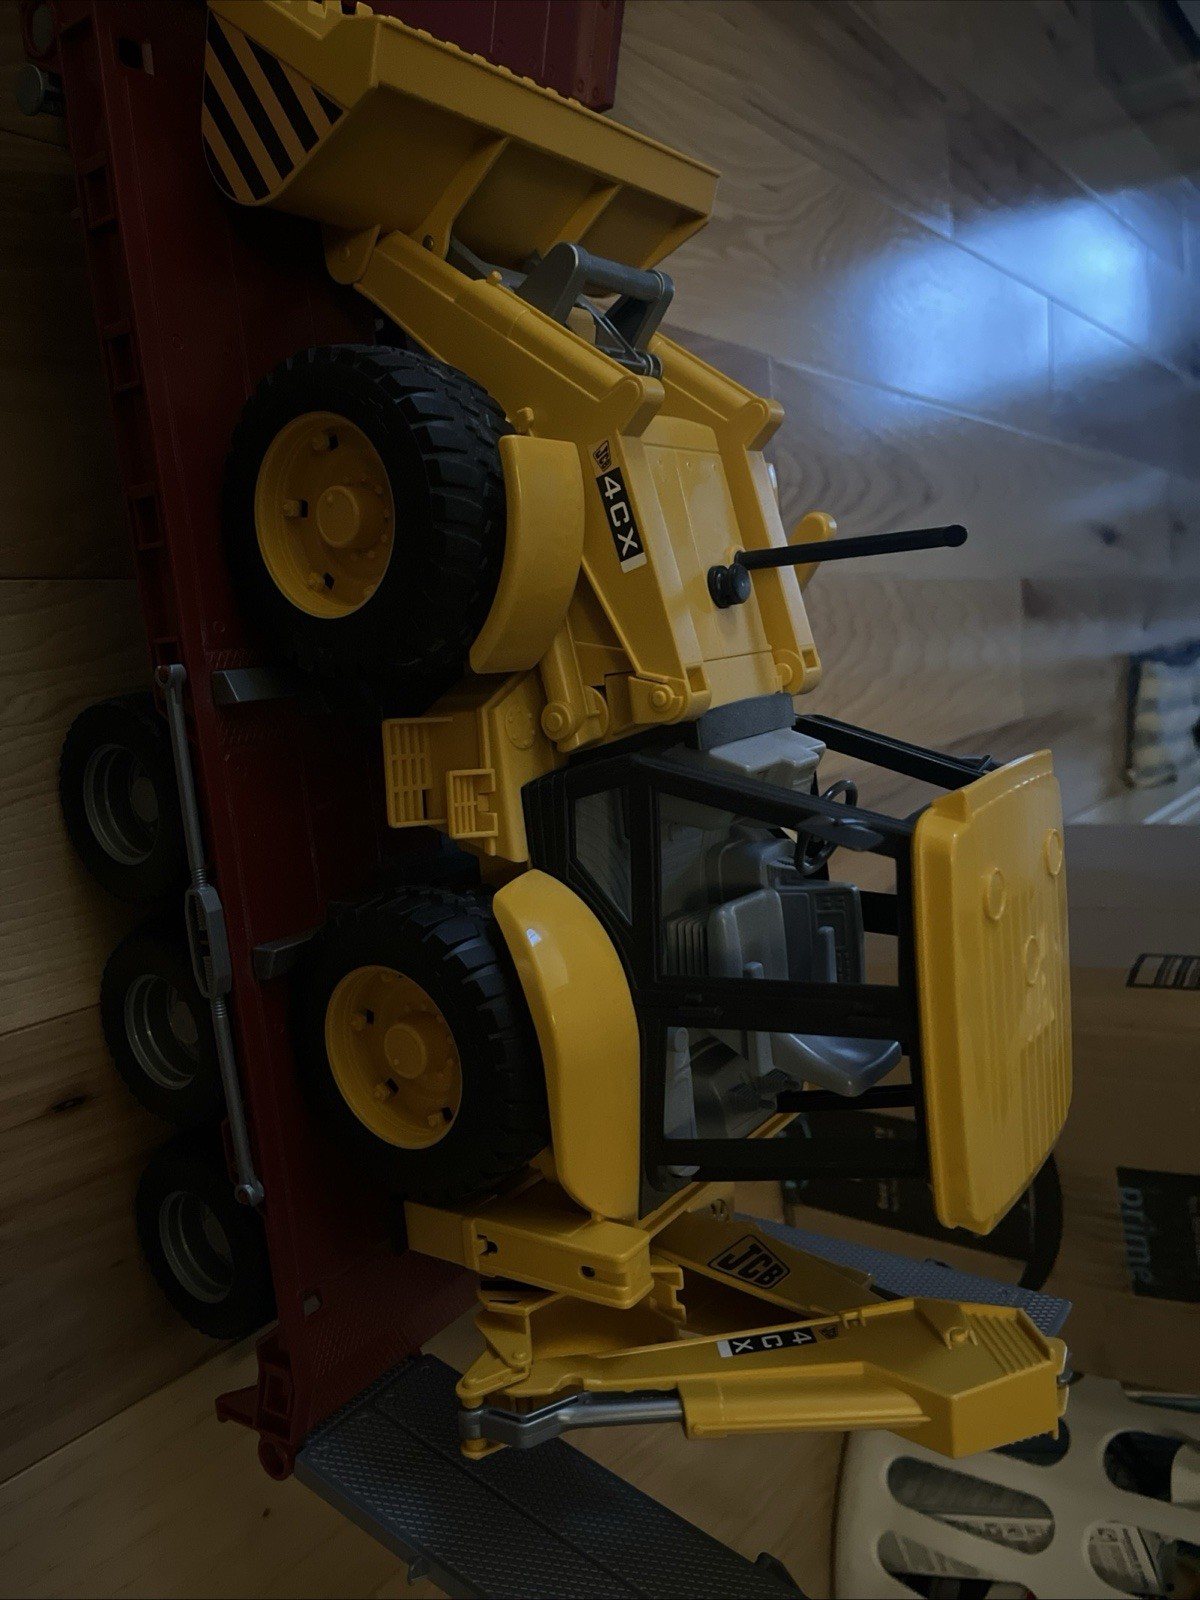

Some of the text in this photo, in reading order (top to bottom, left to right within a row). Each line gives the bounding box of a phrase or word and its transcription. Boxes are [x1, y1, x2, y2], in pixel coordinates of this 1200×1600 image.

[604, 475, 639, 557] 4CX
[717, 1243, 784, 1285] JCB
[731, 1331, 813, 1353] 4CX
